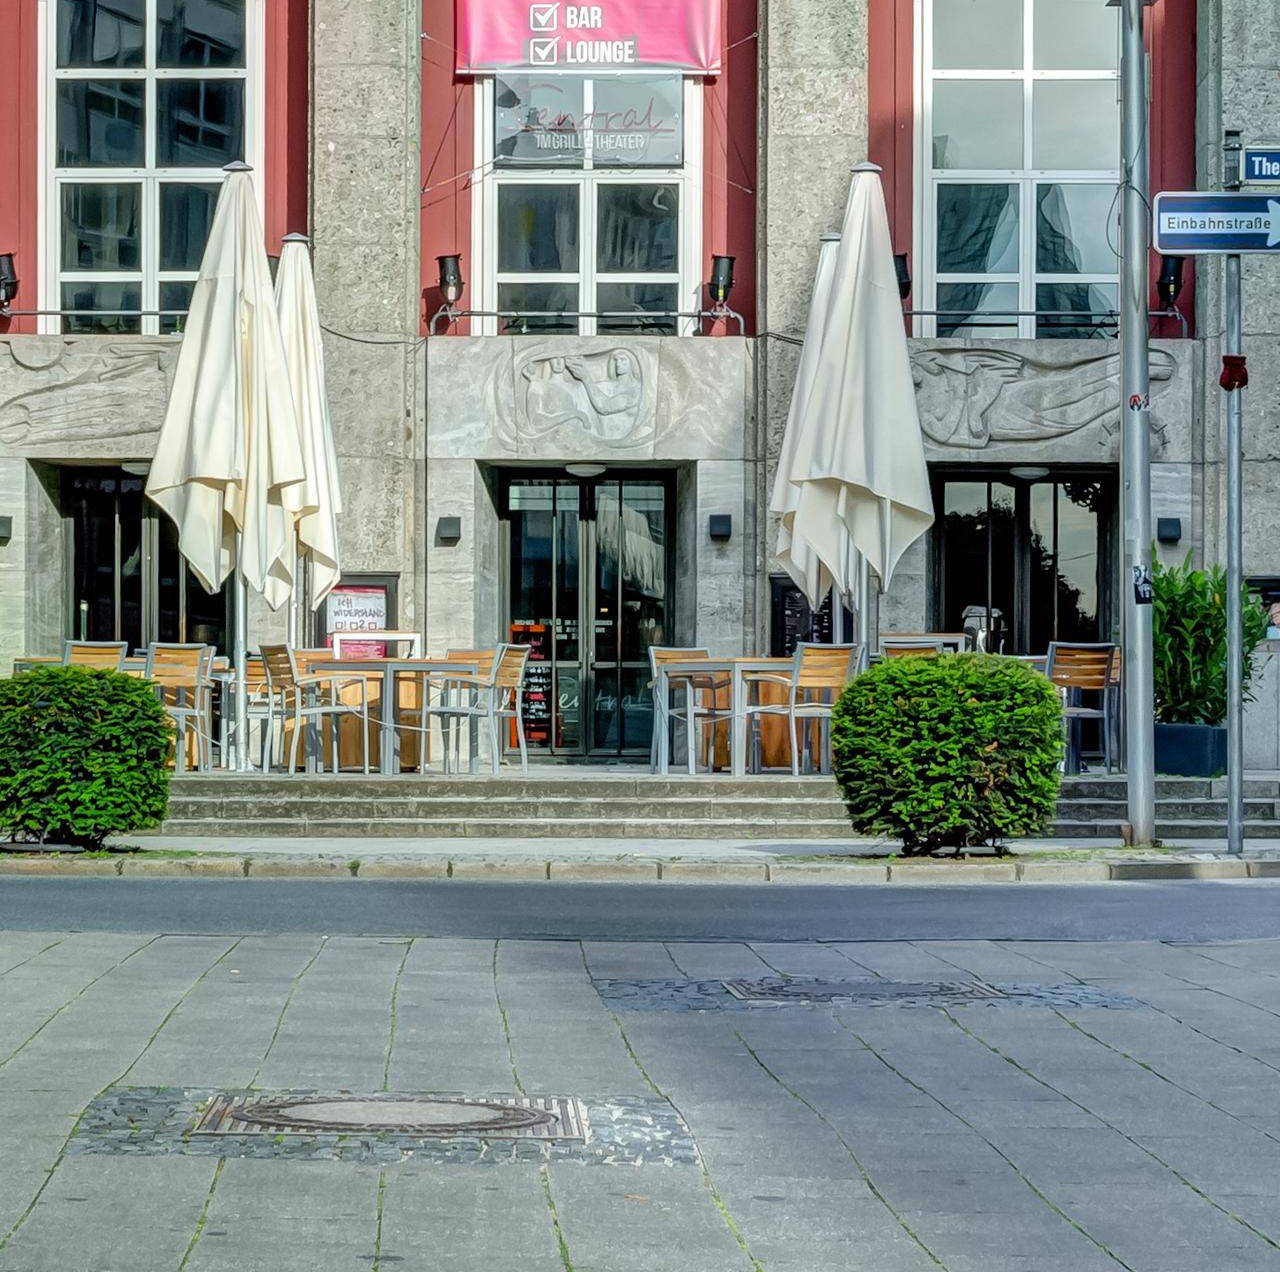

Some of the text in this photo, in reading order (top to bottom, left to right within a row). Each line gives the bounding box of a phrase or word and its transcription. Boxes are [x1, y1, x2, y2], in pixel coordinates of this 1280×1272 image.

[566, 6, 602, 29] BAR
[566, 40, 635, 64] LOUNGE
[1167, 217, 1271, 230] Einbahnstraße
